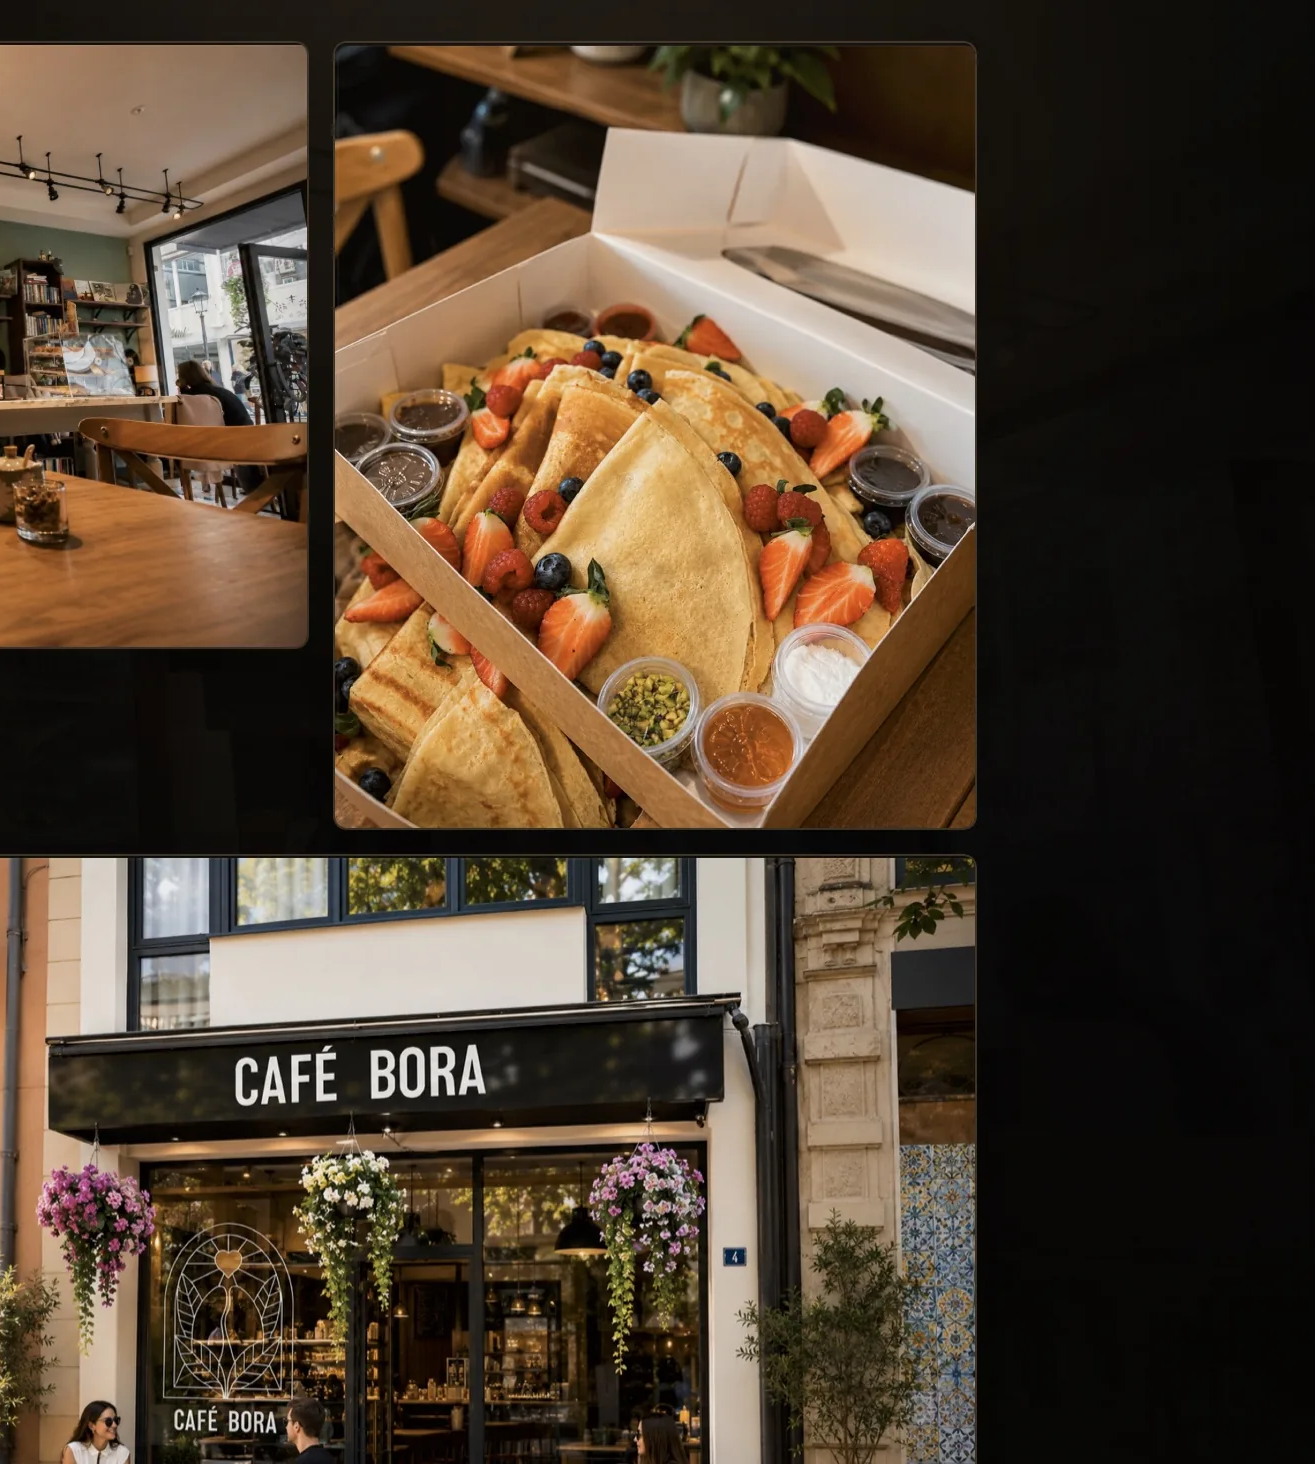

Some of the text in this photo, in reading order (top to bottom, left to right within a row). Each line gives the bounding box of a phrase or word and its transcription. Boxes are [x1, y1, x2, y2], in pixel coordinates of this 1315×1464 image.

[234, 1044, 486, 1106] CAFÉ BORA
[732, 1251, 738, 1263] 4
[173, 1405, 277, 1434] CAFÉ BORA
